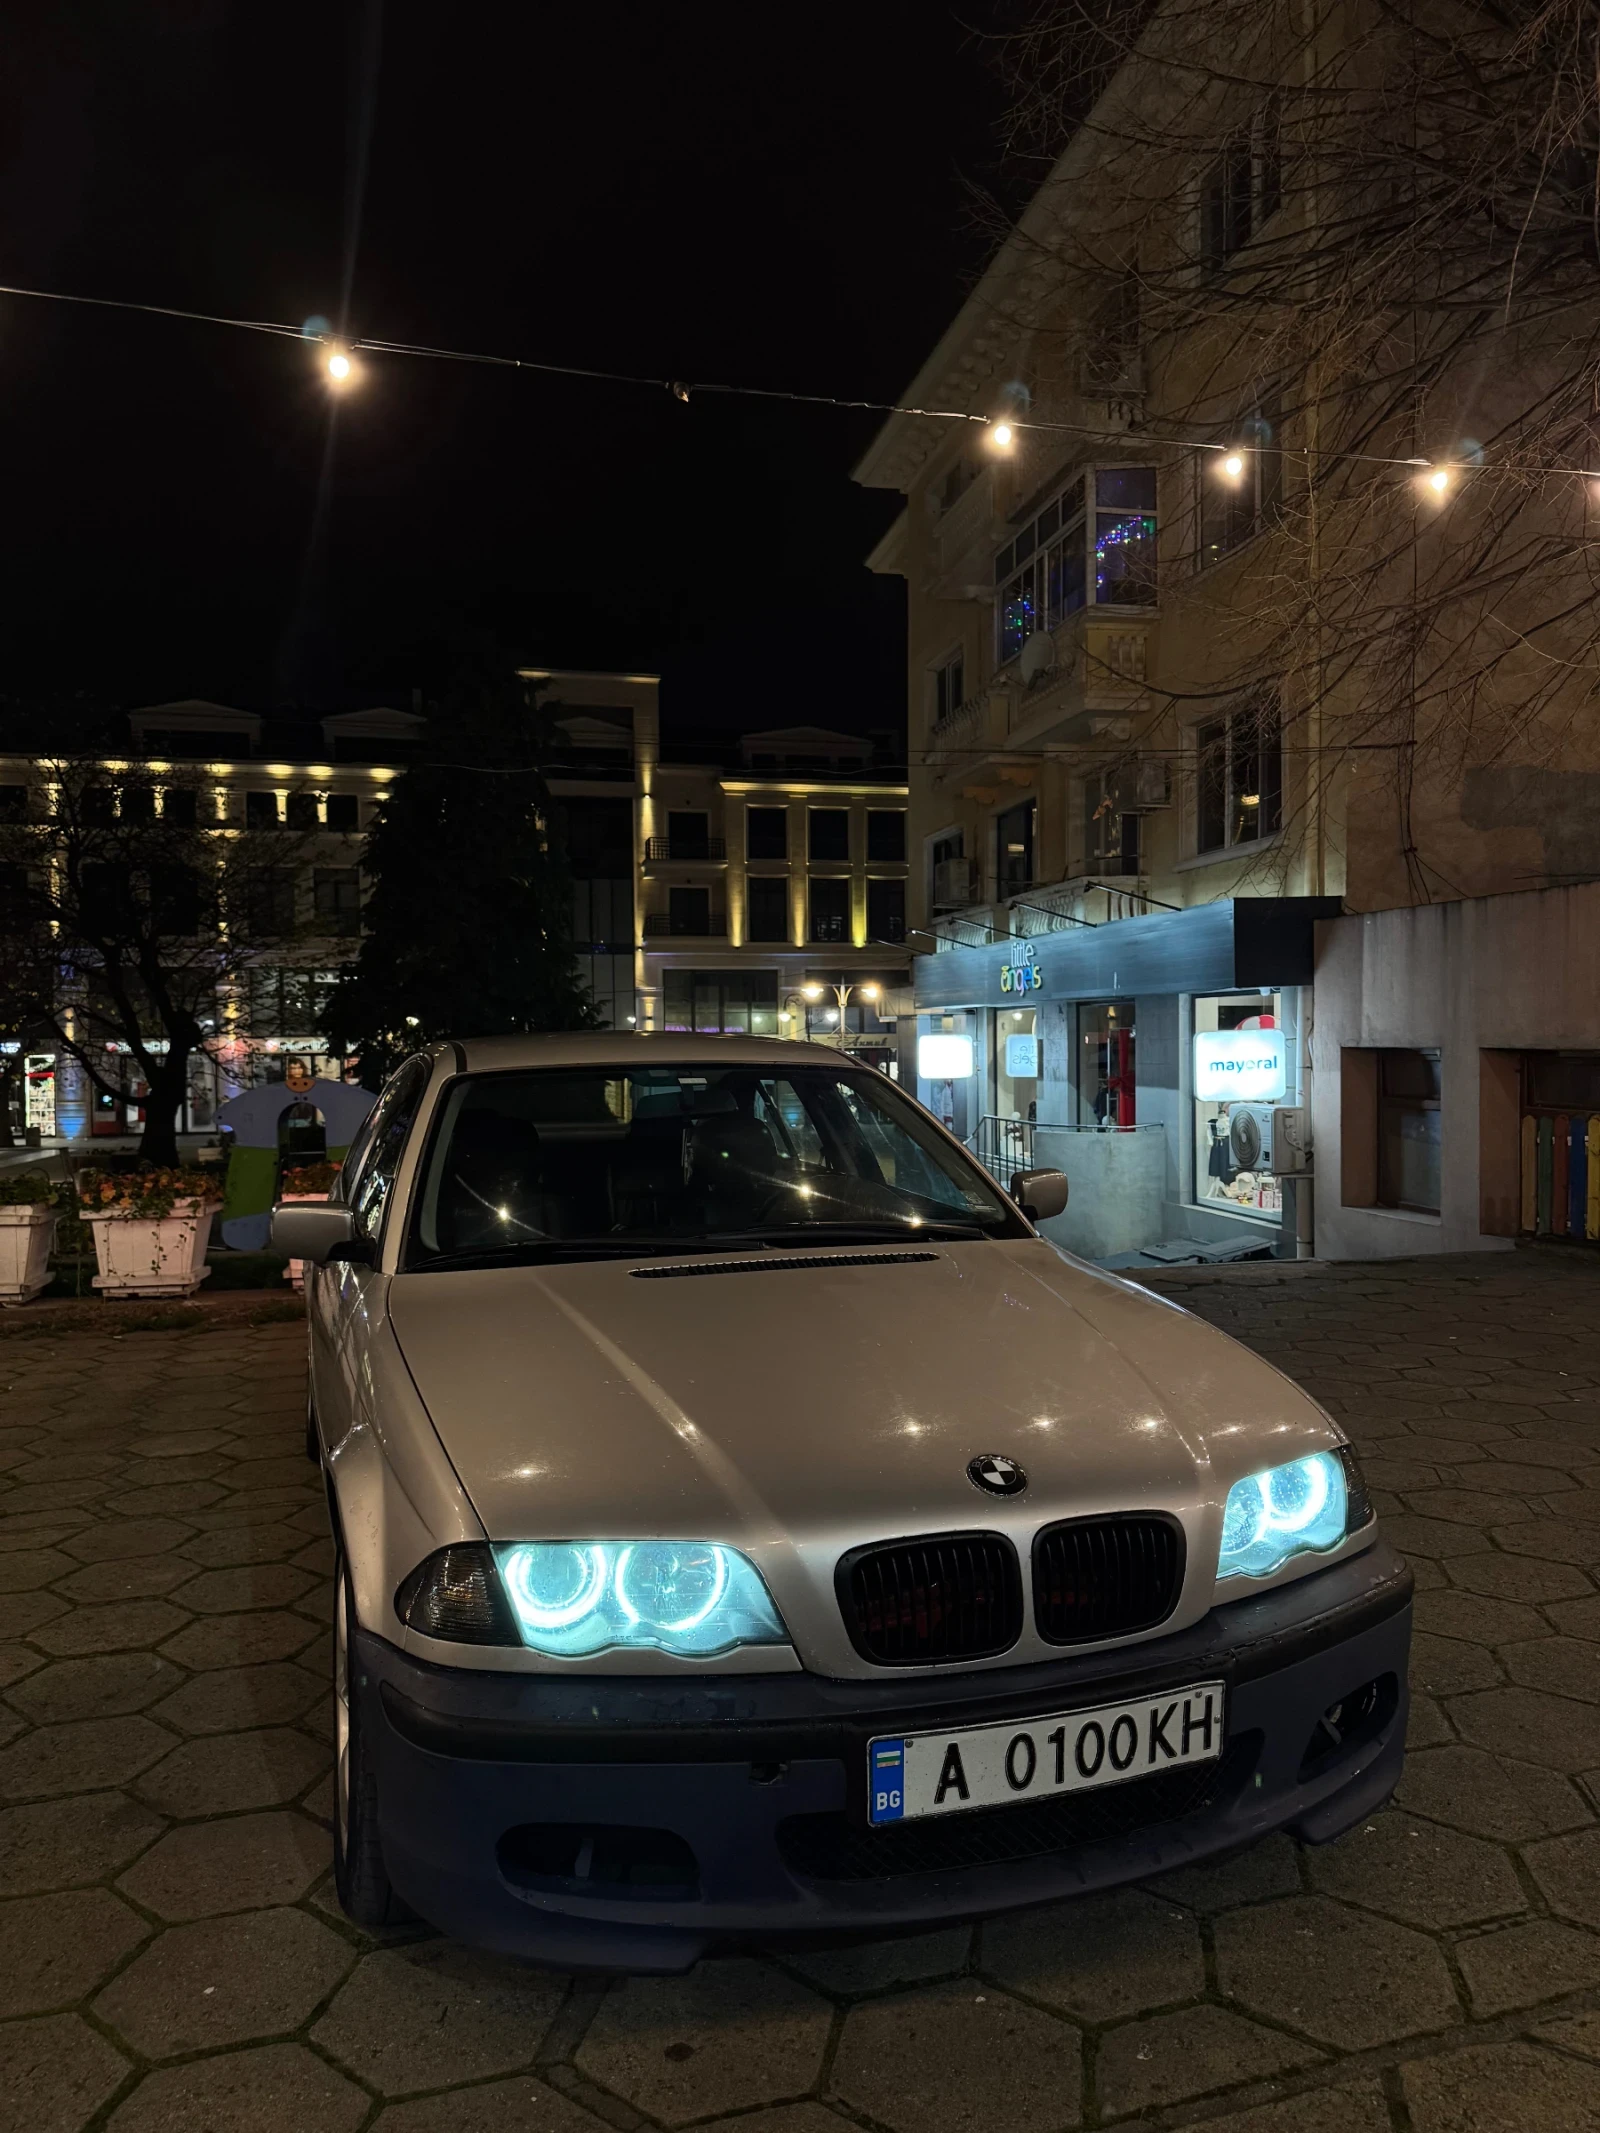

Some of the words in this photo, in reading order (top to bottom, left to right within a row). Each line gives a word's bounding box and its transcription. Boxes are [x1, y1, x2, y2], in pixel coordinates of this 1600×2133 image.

[1010, 941, 1035, 968] little
[1000, 965, 1042, 997] angels
[1209, 1055, 1277, 1074] mayoral
[933, 1742, 971, 1804] A
[875, 1789, 902, 1811] BG
